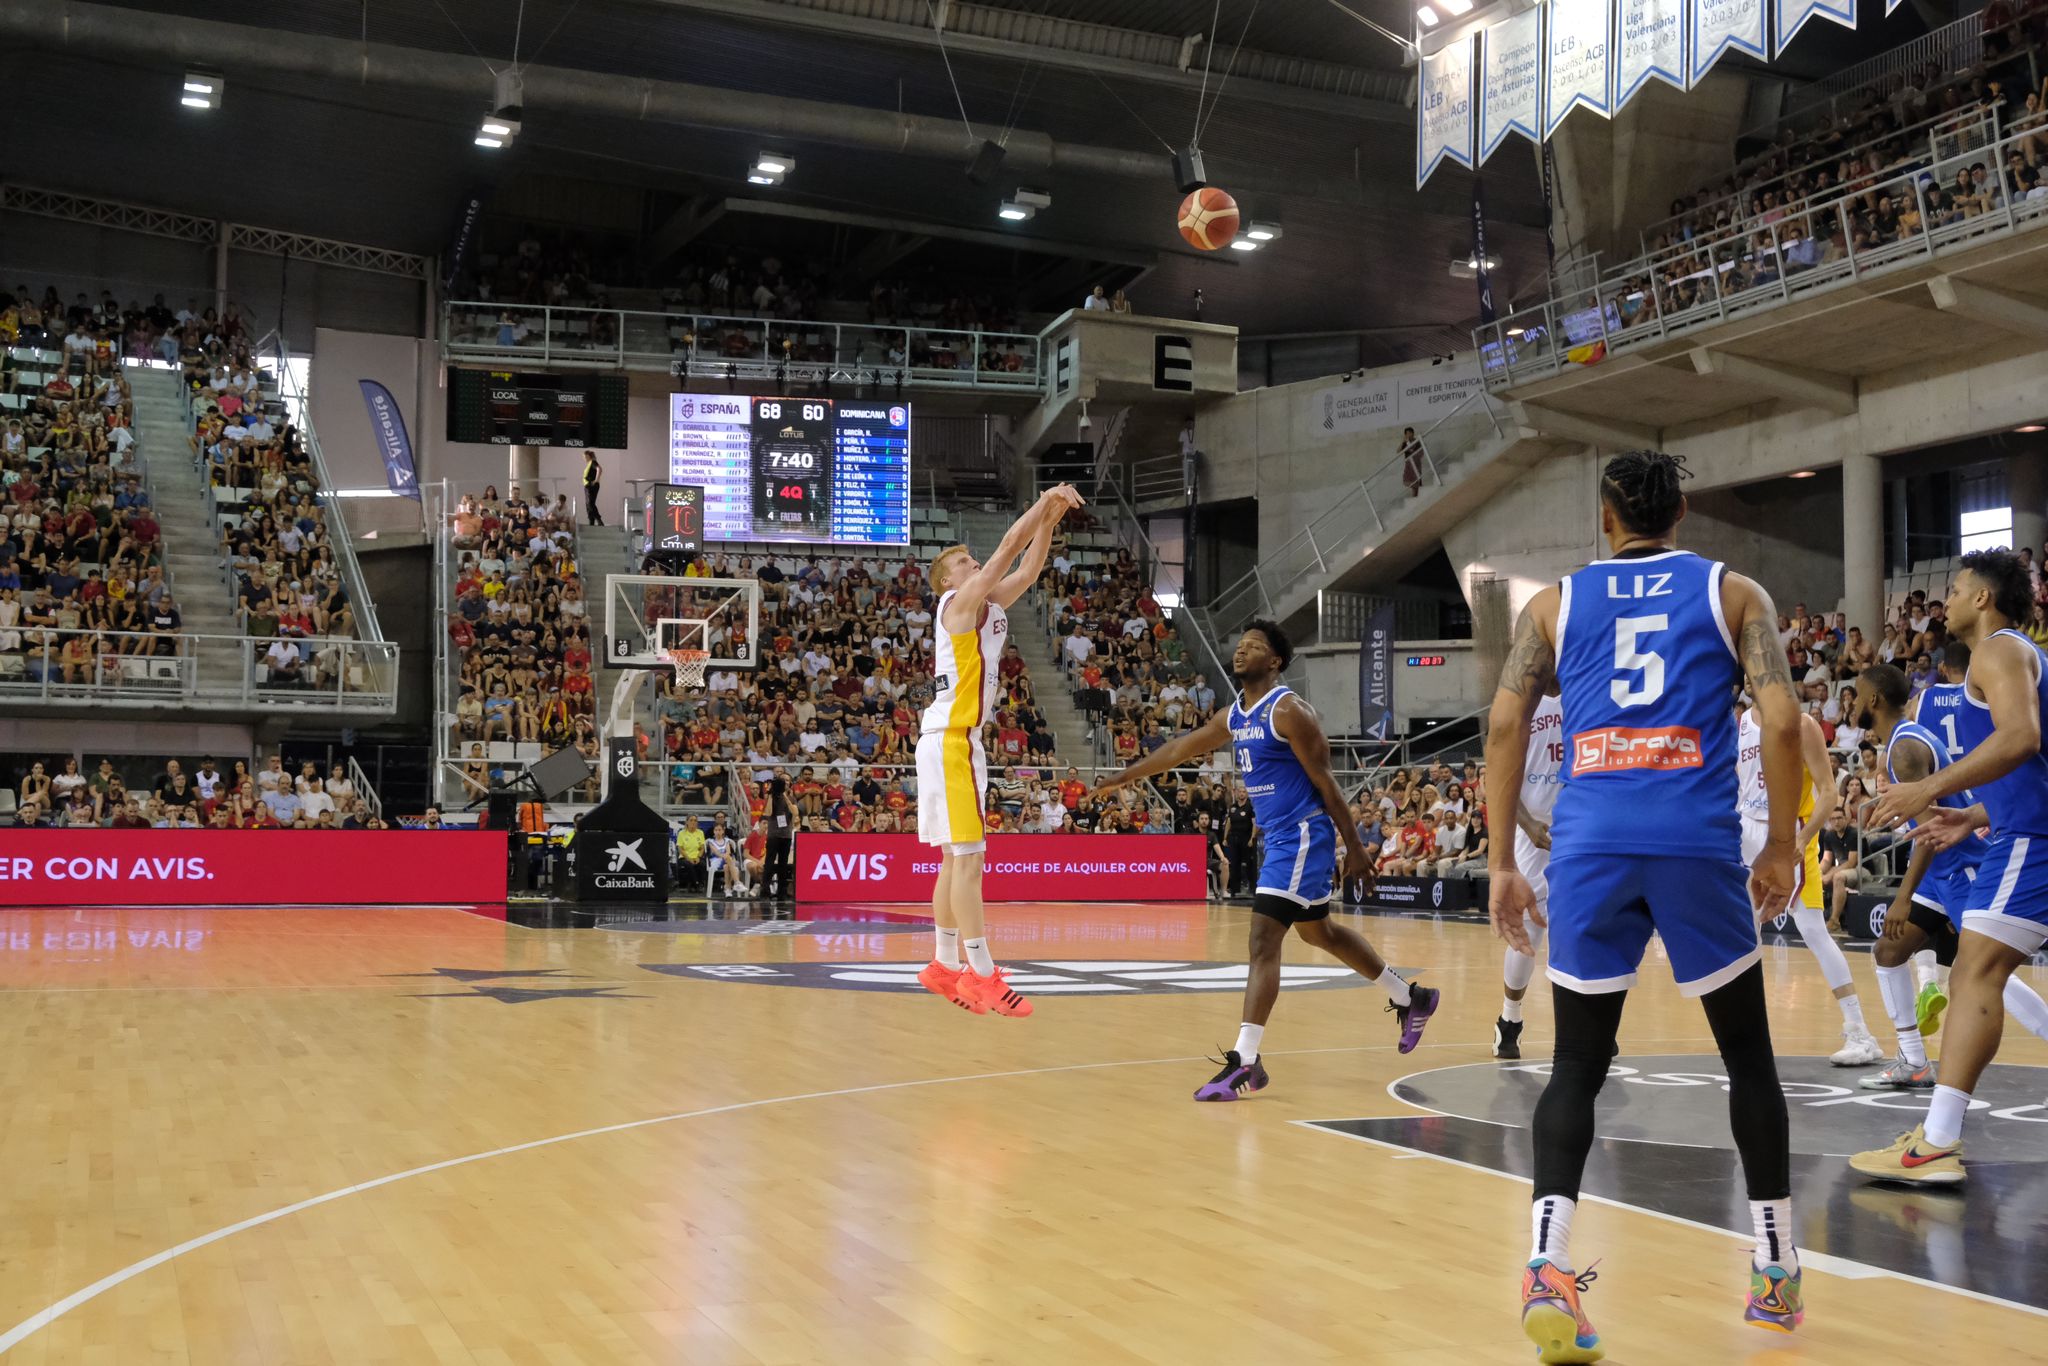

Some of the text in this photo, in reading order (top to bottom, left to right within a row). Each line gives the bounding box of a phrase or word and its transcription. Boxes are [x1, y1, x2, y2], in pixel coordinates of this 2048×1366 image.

[1626, 11, 1643, 26] Liga
[1626, 15, 1676, 40] Valenciana
[1554, 36, 1574, 56] LEB
[1586, 44, 1604, 62] ACB
[1488, 74, 1535, 100] de Asturias
[1425, 92, 1442, 111] LEB
[1450, 100, 1468, 118] ACB
[1154, 336, 1192, 390] E
[493, 391, 519, 400] LOCAL
[558, 394, 584, 402] VISITANTE
[1406, 385, 1432, 396] CENTRE
[1434, 384, 1442, 392] DE
[1428, 390, 1468, 404] ESPORTIVA
[701, 402, 740, 414] ESPAÑA
[1336, 392, 1388, 409] GENERALITAT
[760, 403, 781, 419] 68
[803, 405, 824, 420] 60
[840, 410, 886, 419] DOMINICANA
[1338, 405, 1387, 419] VALENCIANA
[770, 452, 813, 468] 7:40
[766, 488, 773, 497] 0
[780, 486, 803, 499] 4Q
[812, 490, 815, 498] 1
[768, 512, 814, 522] 4 FALTAS 1
[1608, 573, 1673, 598] LIZ
[1370, 629, 1384, 706] Alicante
[1610, 614, 1668, 709] 5
[1940, 714, 1964, 754] 1
[1610, 732, 1696, 753] brava
[1609, 752, 1698, 766] lubricants
[44, 857, 118, 880] CON
[129, 857, 214, 880] AVIS.
[812, 854, 888, 881] AVIS
[983, 863, 991, 873] U
[995, 863, 1040, 873] COCHE
[1043, 863, 1061, 873] DE
[1064, 863, 1126, 875] ALQUILER
[1130, 863, 1156, 873] CON
[1159, 863, 1191, 873] AVIS.
[595, 876, 655, 889] CaixaBank
